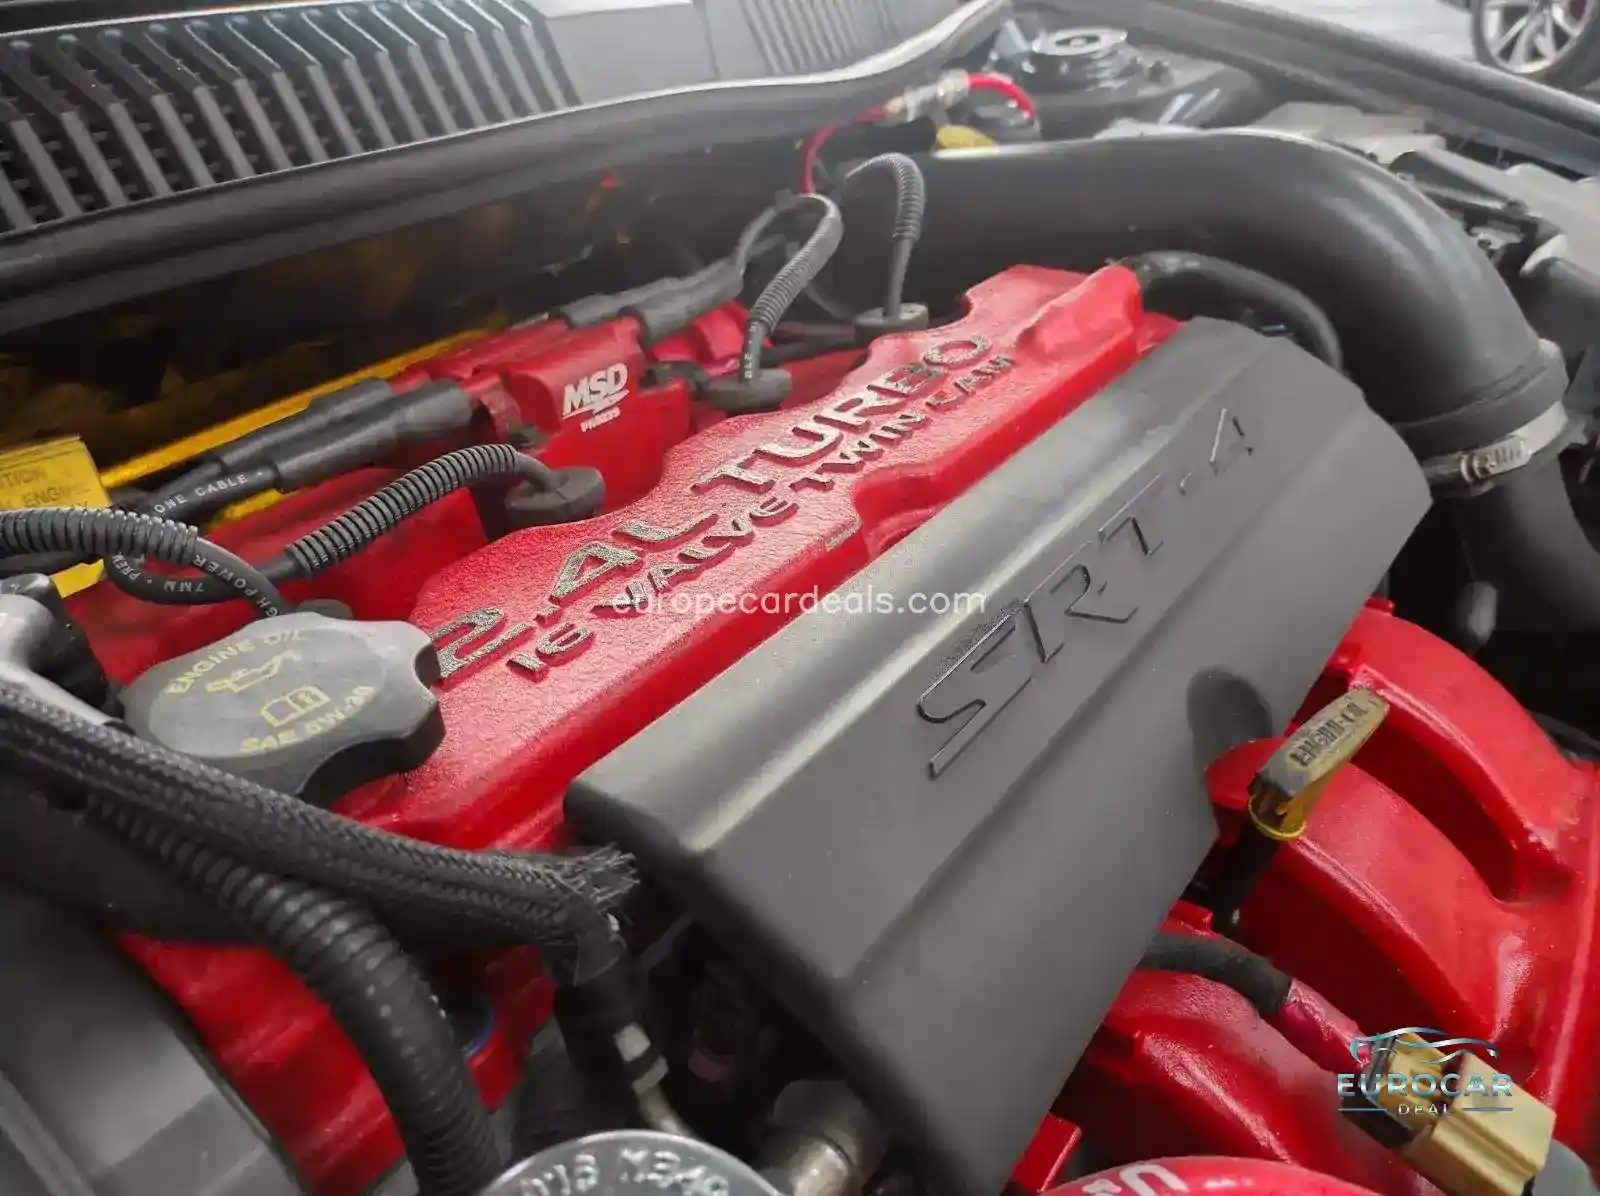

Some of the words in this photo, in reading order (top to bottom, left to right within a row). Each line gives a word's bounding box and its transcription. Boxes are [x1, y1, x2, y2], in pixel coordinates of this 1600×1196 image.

[563, 362, 628, 416] MSD
[690, 334, 993, 493] TURBO
[194, 474, 249, 498] CABLE
[506, 622, 592, 682] 16
[590, 496, 800, 617] VALVE
[790, 411, 930, 490] TWIN
[926, 355, 1016, 411] CAM
[167, 640, 254, 695] ENGINE
[263, 628, 307, 646] OIL
